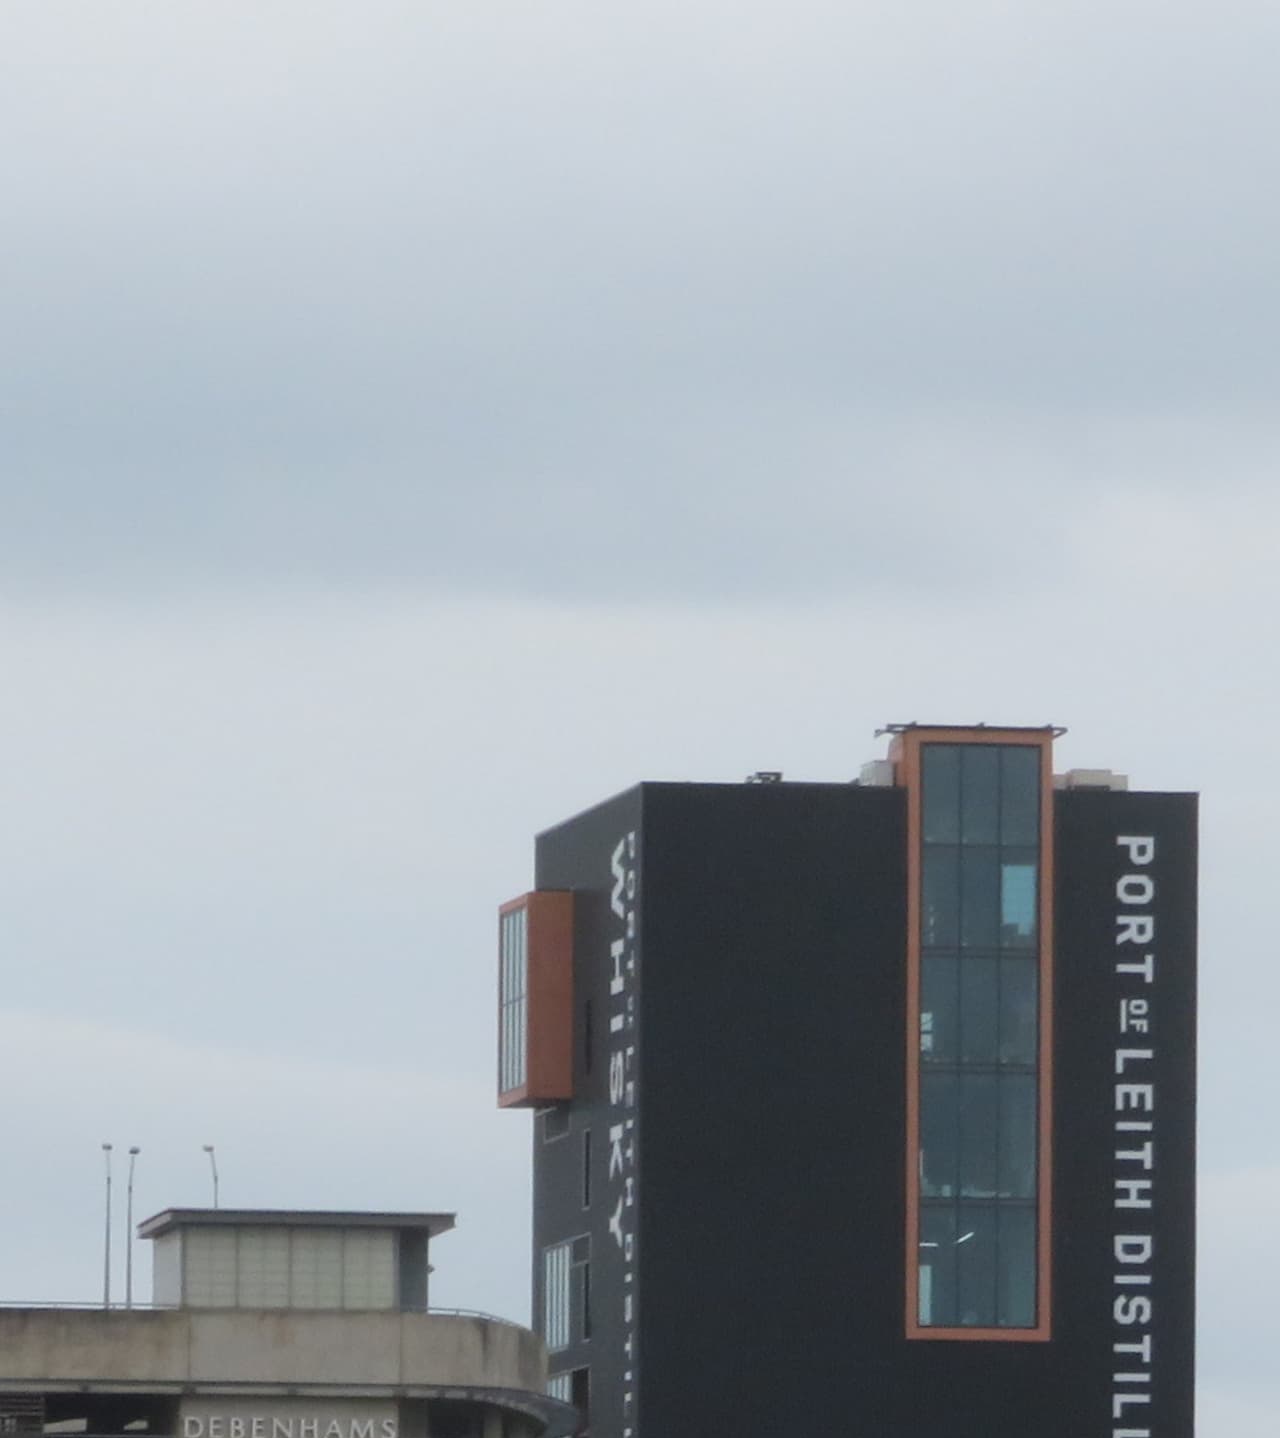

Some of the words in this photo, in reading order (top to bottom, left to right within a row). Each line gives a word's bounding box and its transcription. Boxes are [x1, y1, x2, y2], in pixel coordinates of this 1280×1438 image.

[1115, 835, 1155, 984] PORT
[608, 836, 625, 1249] WHISKY
[1126, 999, 1149, 1034] OF
[1114, 1048, 1154, 1209] LEITH
